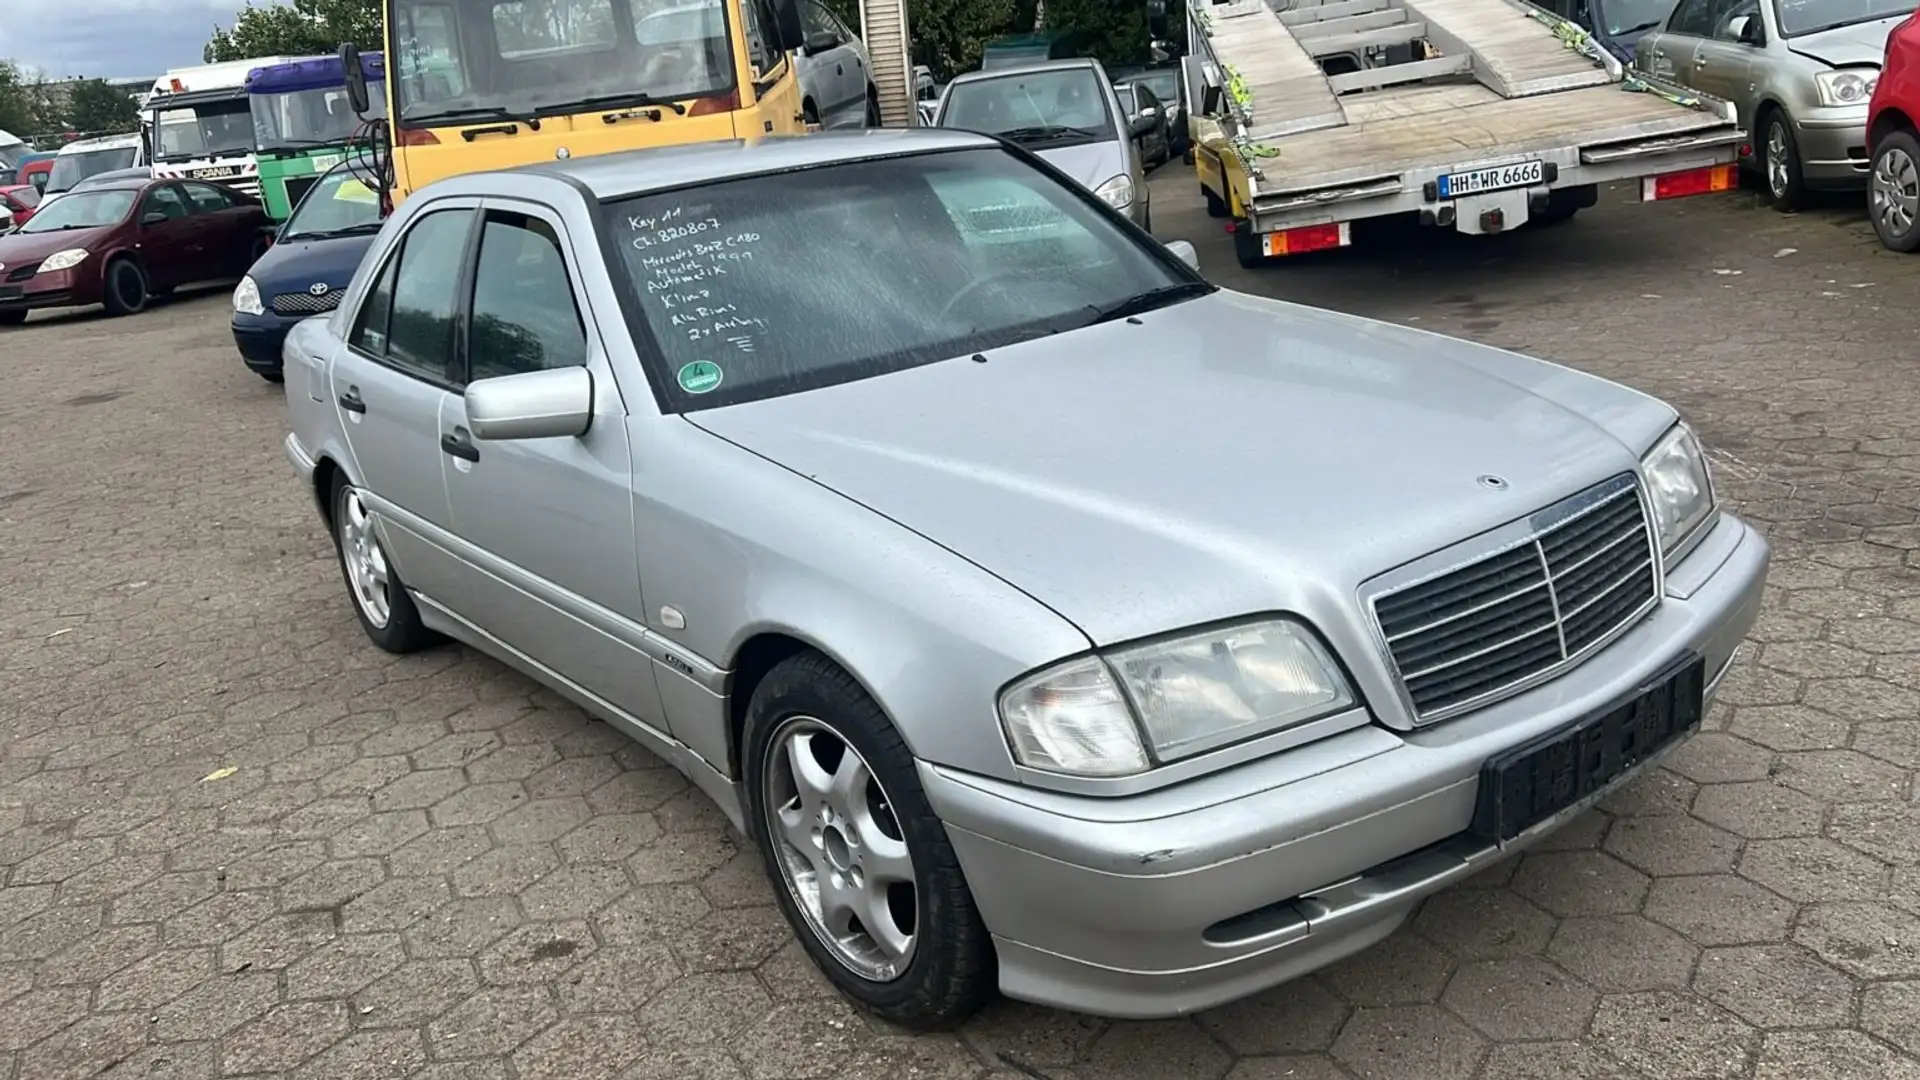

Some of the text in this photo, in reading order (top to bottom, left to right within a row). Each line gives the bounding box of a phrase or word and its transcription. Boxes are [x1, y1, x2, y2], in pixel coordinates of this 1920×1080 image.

[192, 167, 234, 179] SCANIA
[1450, 163, 1540, 194] HH WR 6666
[628, 207, 681, 232] Key 11
